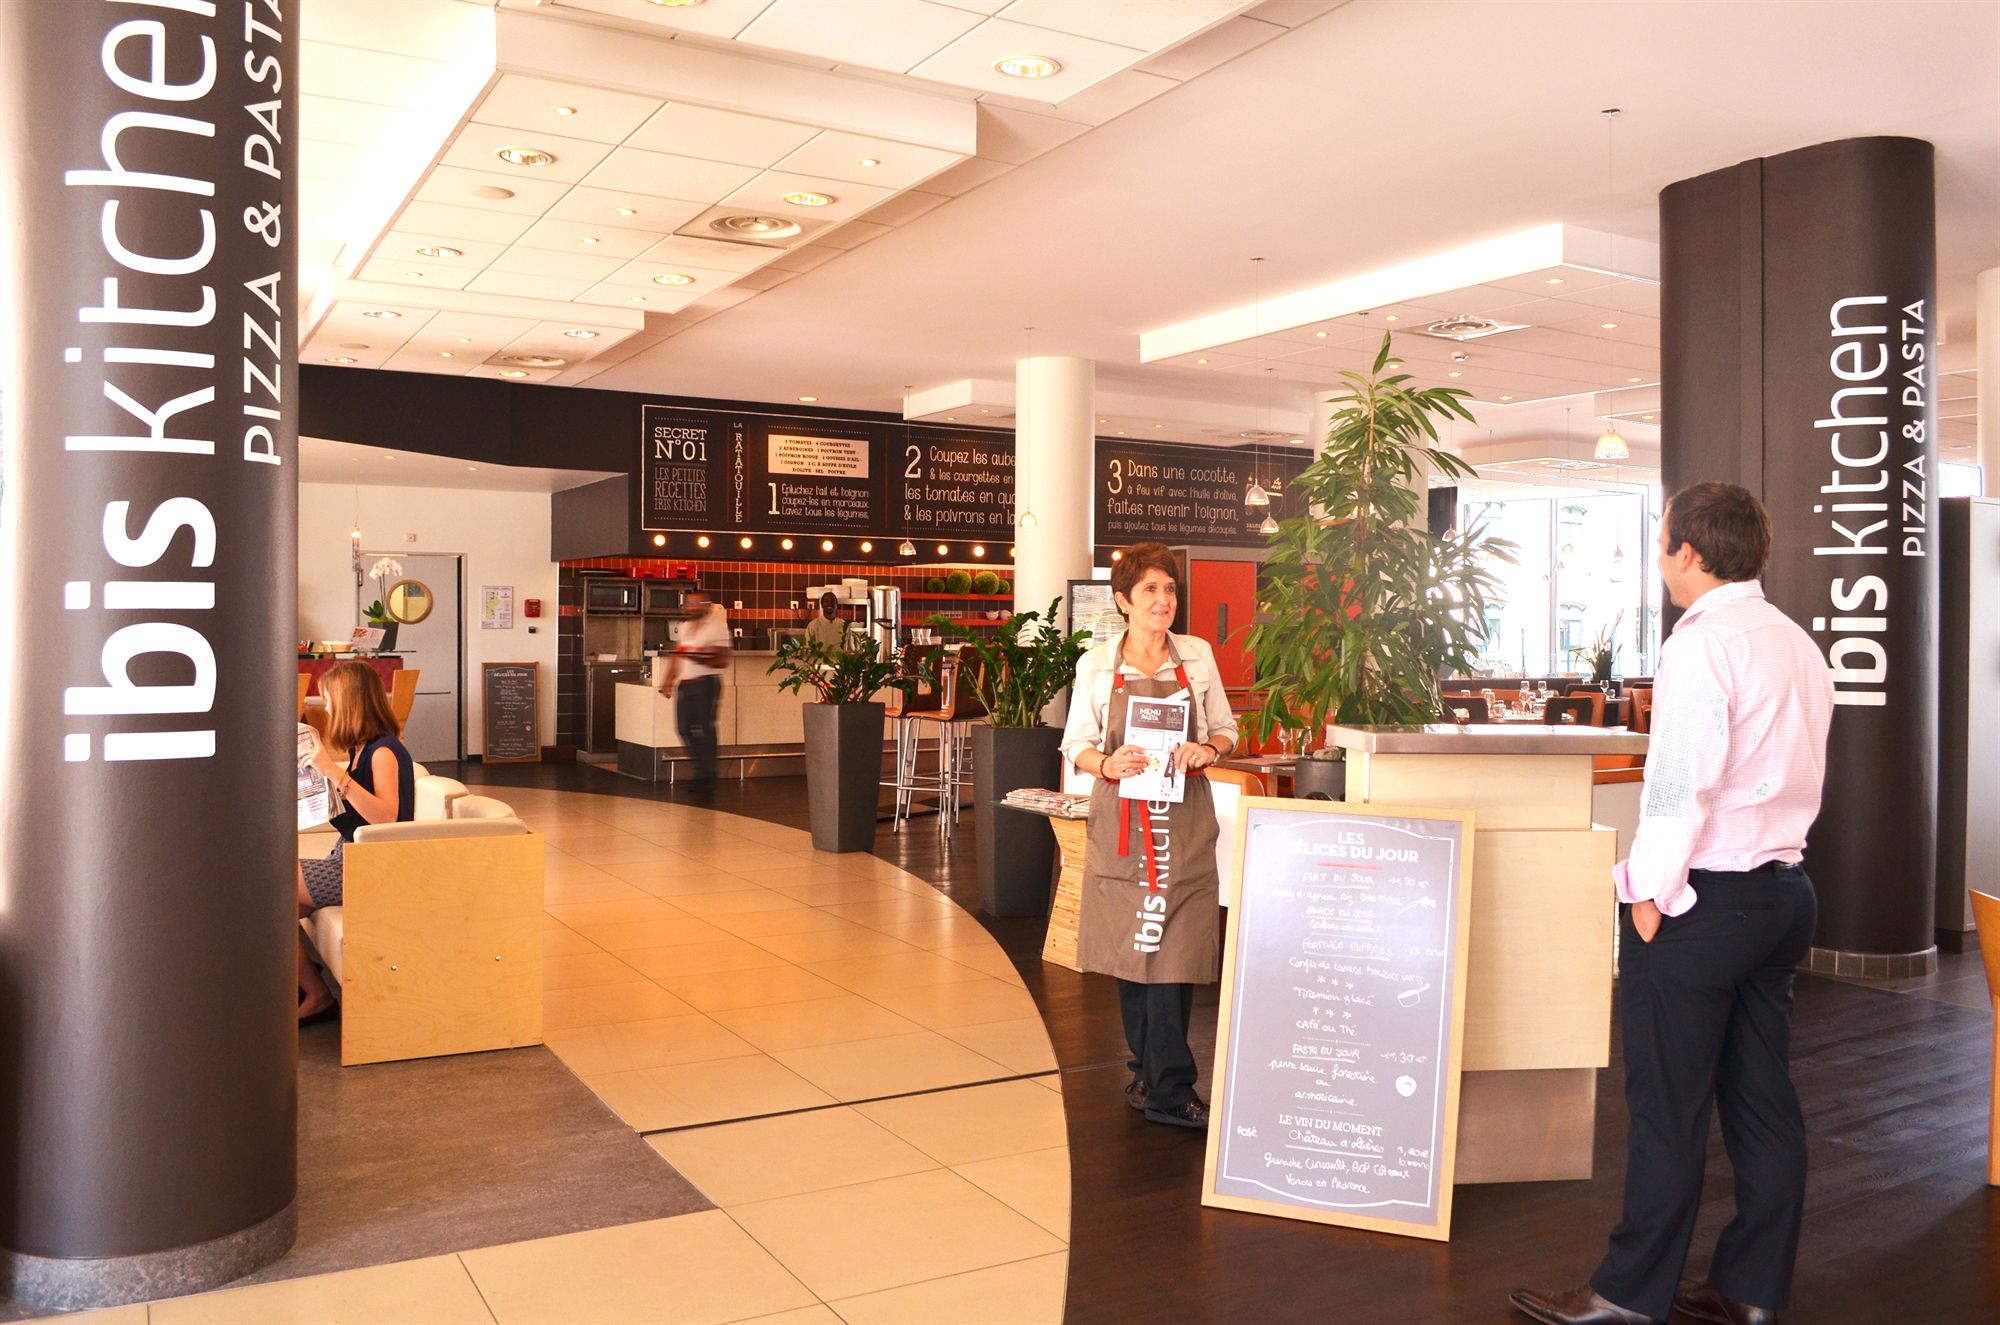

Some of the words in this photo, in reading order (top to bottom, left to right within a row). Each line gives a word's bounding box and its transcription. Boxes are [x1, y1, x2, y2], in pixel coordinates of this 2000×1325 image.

[243, 200, 281, 247] &
[1902, 299, 1926, 407] PASTA
[243, 272, 282, 465] PIZZA
[654, 426, 707, 440] SECRET
[1813, 295, 1889, 556] kitchen
[1902, 419, 1926, 443] &
[904, 444, 922, 479] 2
[929, 445, 969, 467] Coupez
[972, 448, 988, 465] les
[654, 467, 669, 480] LES
[672, 468, 706, 482] PETITES
[734, 432, 744, 523] RATATOUILLE
[929, 467, 936, 480] &
[939, 468, 951, 481] les
[953, 471, 1000, 486] courgettes
[1003, 474, 1014, 484] en
[1107, 459, 1123, 494] 3
[1127, 459, 1158, 478] Dans
[1162, 466, 1185, 480] une
[654, 481, 707, 499] RECETTES
[768, 482, 780, 515] 1
[829, 486, 839, 497] et
[904, 482, 921, 500] les
[925, 484, 975, 502] tomates
[979, 491, 994, 504] en
[1136, 484, 1151, 495] feu
[1153, 485, 1165, 497] vif
[1168, 489, 1187, 498] avec
[673, 499, 707, 512] KITCHEN
[781, 505, 803, 516] Lavez
[805, 506, 822, 517] tous
[824, 507, 835, 517] les
[821, 498, 831, 506] en
[1107, 497, 1144, 515] faites
[1147, 503, 1191, 518] revenir
[1902, 455, 1926, 557] PIZZA
[904, 504, 911, 521] &
[916, 504, 932, 521] les
[935, 508, 985, 527] poivrons
[989, 512, 1003, 525] en
[1107, 521, 1122, 532] puis
[1124, 521, 1150, 533] ajoutez
[1151, 522, 1166, 531] tous
[1168, 522, 1178, 532] les
[64, 497, 217, 762] ibis
[1139, 707, 1162, 717] MENU
[1140, 713, 1159, 721] PASTA
[1138, 799, 1170, 889] kitche
[1337, 832, 1365, 845] LES
[1349, 846, 1373, 860] DU
[1375, 848, 1419, 863] JOUR
[1133, 895, 1167, 953] ibis
[1335, 1048, 1360, 1059] JOUR
[1278, 1114, 1293, 1125] LE
[1294, 1115, 1313, 1128] VIN
[1314, 1118, 1331, 1130] DU
[1332, 1120, 1383, 1136] MOMENT
